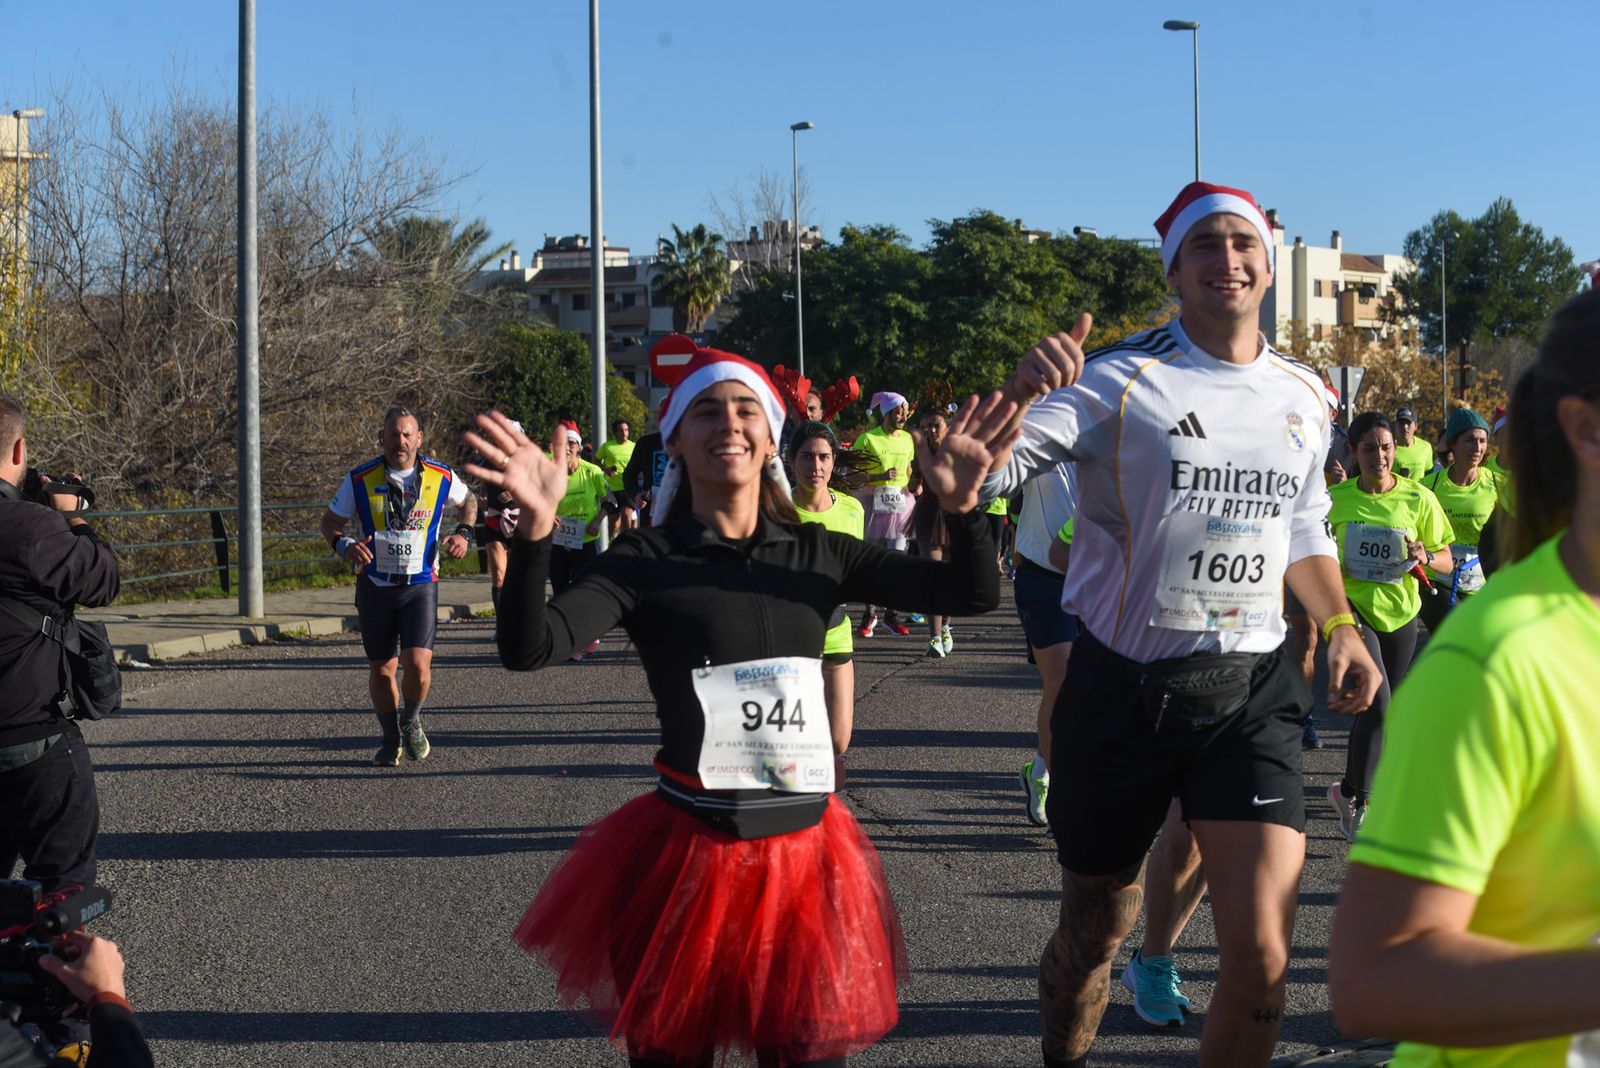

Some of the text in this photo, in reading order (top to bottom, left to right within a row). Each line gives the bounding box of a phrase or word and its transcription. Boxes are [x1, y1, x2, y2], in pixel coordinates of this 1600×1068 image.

[1171, 460, 1300, 499] Emirates
[880, 494, 901, 503] 1326
[388, 543, 412, 556] 588
[1359, 542, 1391, 560] 508
[1188, 550, 1265, 583] 1603
[741, 699, 806, 732] 944
